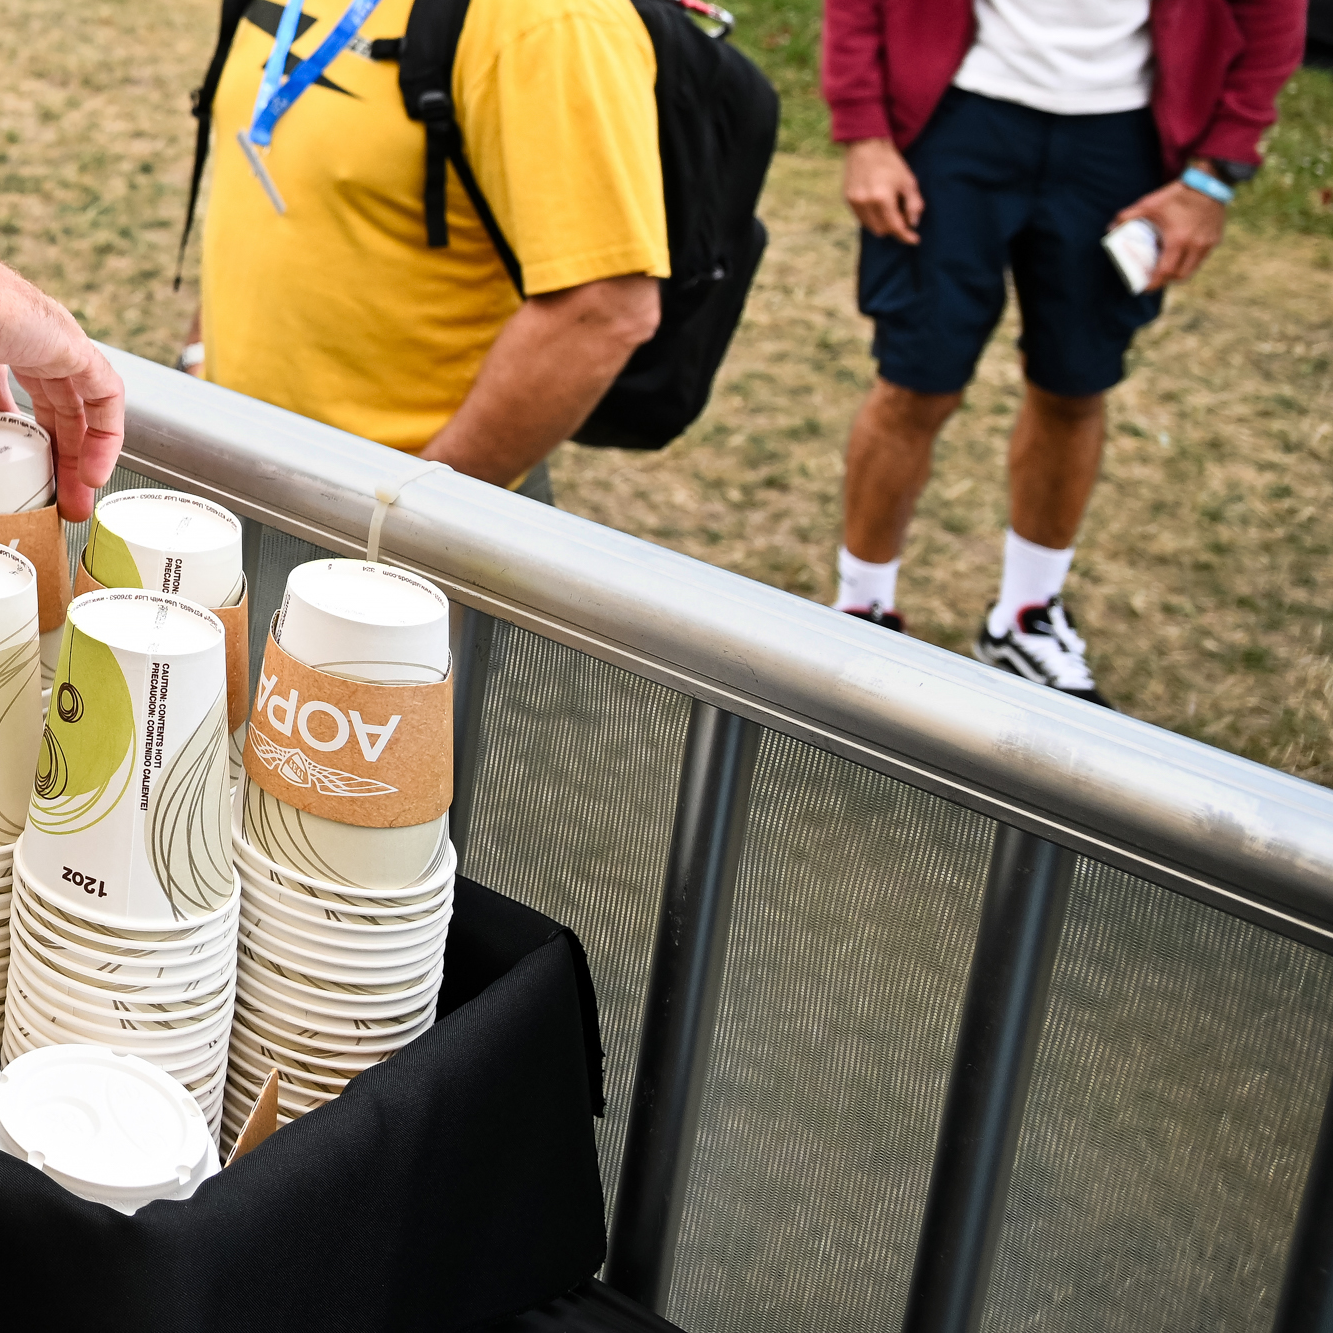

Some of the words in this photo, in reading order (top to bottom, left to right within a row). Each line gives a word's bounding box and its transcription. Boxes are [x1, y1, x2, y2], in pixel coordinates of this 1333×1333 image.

[179, 496, 191, 504] with
[192, 500, 203, 509] Use
[172, 558, 183, 595] CAUTION:
[165, 598, 177, 607] Use
[148, 662, 160, 718] PRECAUCION:
[159, 663, 170, 702] CAUTION:
[155, 703, 167, 747] CONTENTS
[256, 674, 402, 763] AOPA
[143, 719, 155, 767] CONTENIDO
[140, 768, 151, 811] CALIENTE!
